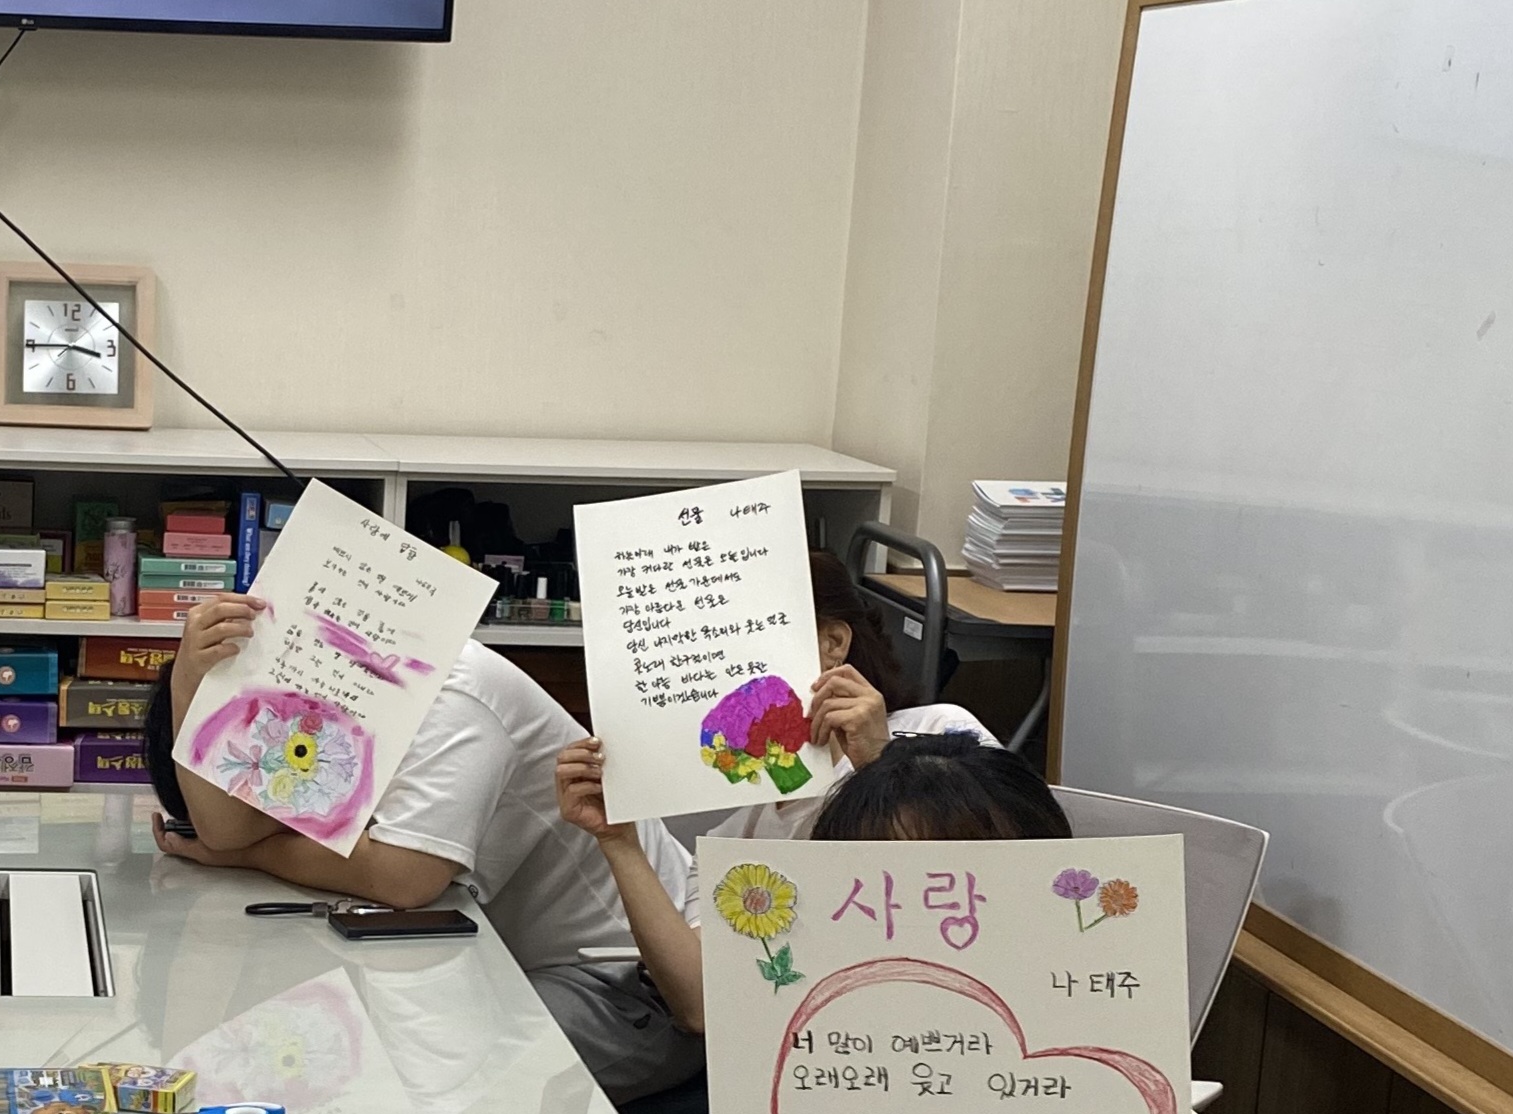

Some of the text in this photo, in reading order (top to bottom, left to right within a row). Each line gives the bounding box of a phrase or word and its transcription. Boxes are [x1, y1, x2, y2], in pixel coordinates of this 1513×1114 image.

[63, 303, 80, 321] 12
[107, 340, 116, 357] 3
[67, 373, 76, 391] 6
[678, 502, 771, 526] 선물 나태주
[831, 870, 986, 950] 사랑
[792, 1030, 813, 1054] 너
[892, 1030, 994, 1055] 예쁘거라
[910, 1062, 953, 1096] 웃고
[988, 1071, 1072, 1100] 있거라
